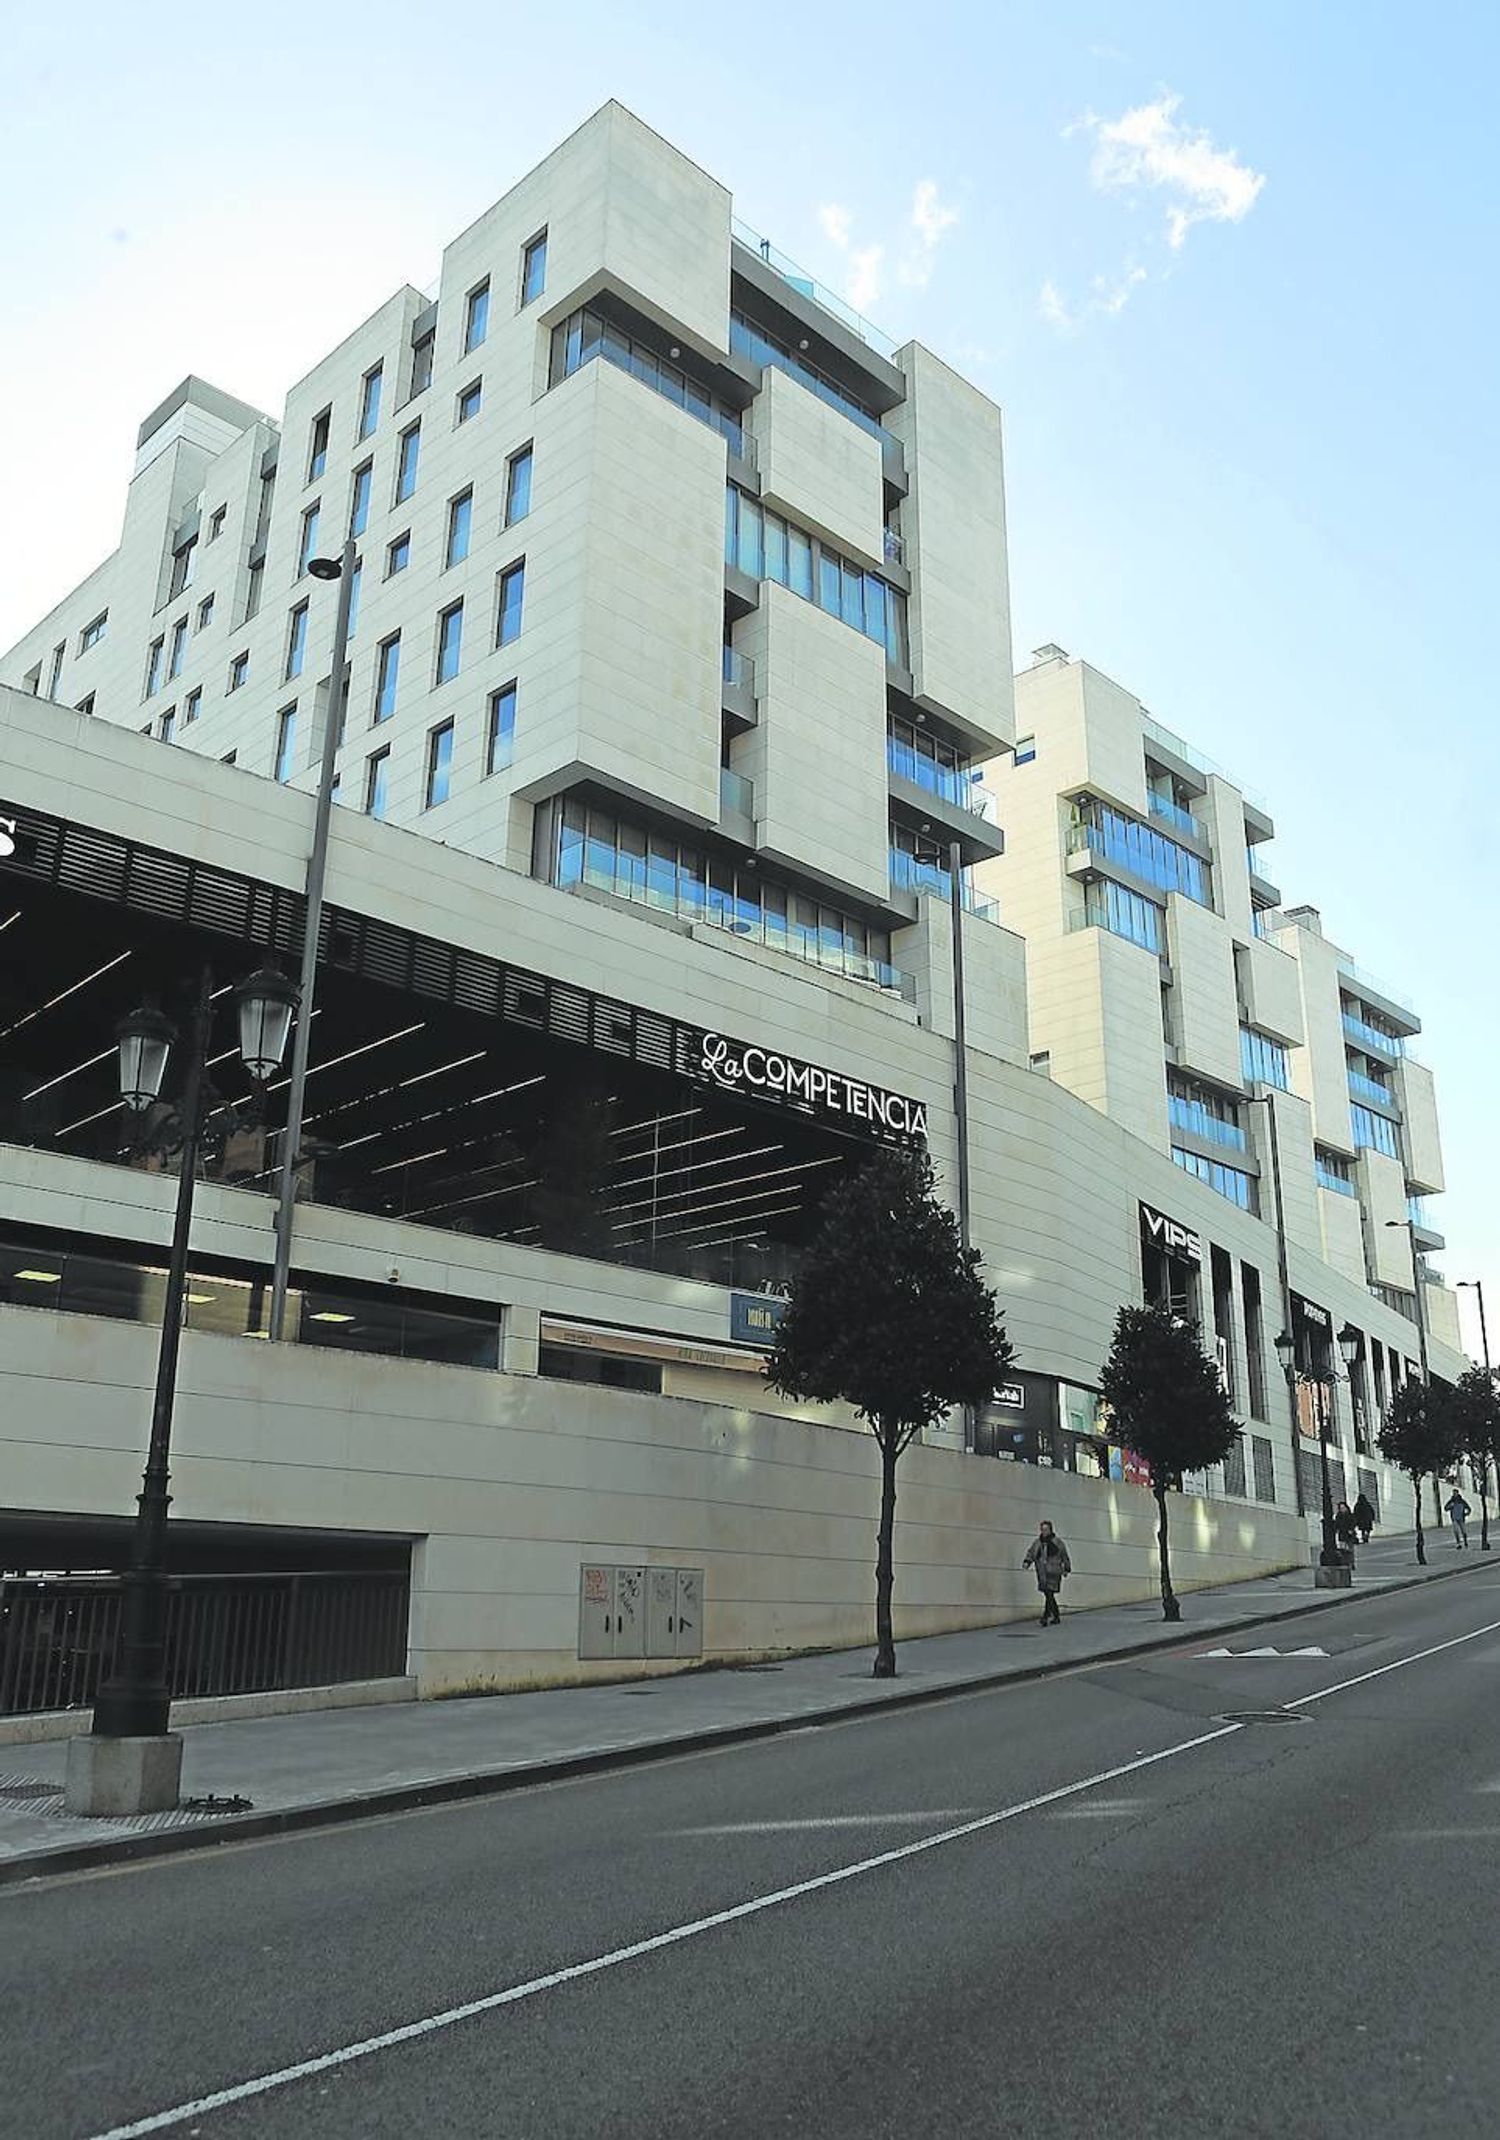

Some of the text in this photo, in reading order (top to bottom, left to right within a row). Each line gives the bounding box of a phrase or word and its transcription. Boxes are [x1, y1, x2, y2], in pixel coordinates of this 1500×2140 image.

[702, 1033, 929, 1138] La COMPETENCIA
[1142, 1206, 1203, 1261] VIPS
